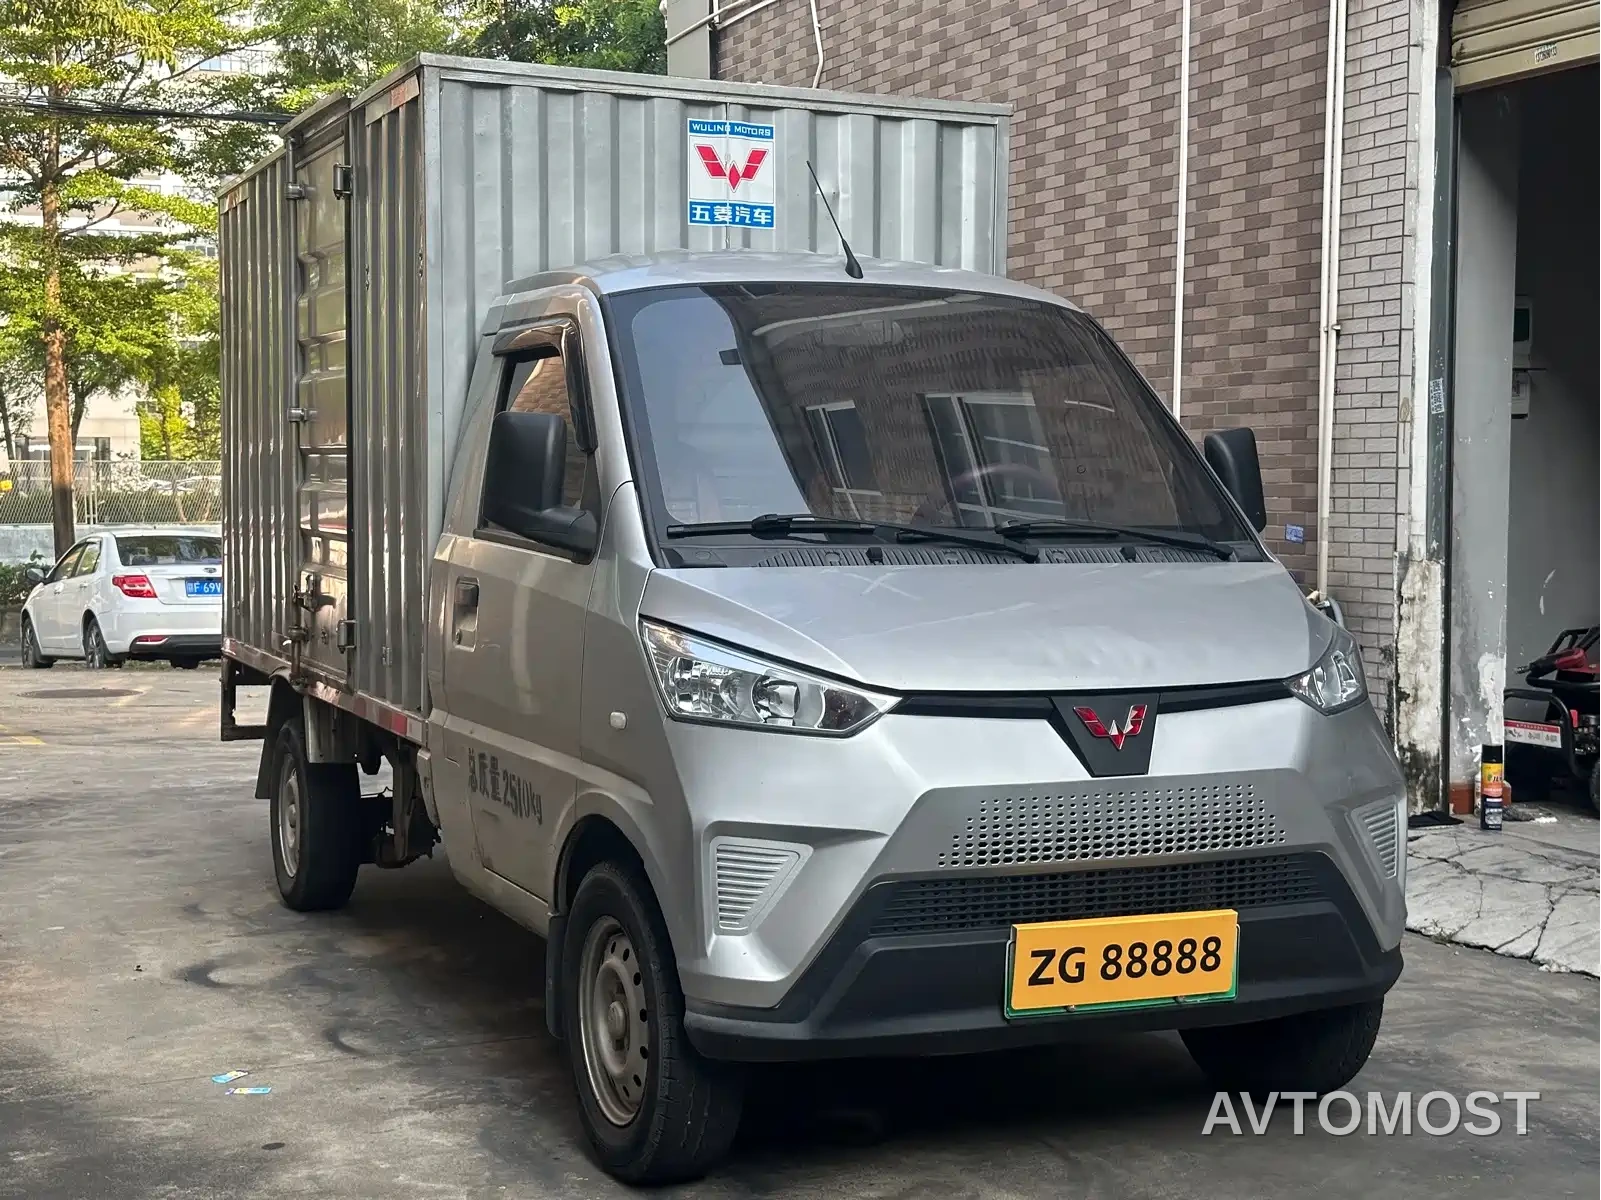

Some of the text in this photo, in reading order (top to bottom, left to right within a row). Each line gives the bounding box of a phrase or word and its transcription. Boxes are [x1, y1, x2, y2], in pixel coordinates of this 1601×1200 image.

[692, 123, 771, 137] WULING MOTORS
[691, 204, 772, 225] 五菱汽车
[1027, 935, 1222, 987] ZG 88888
